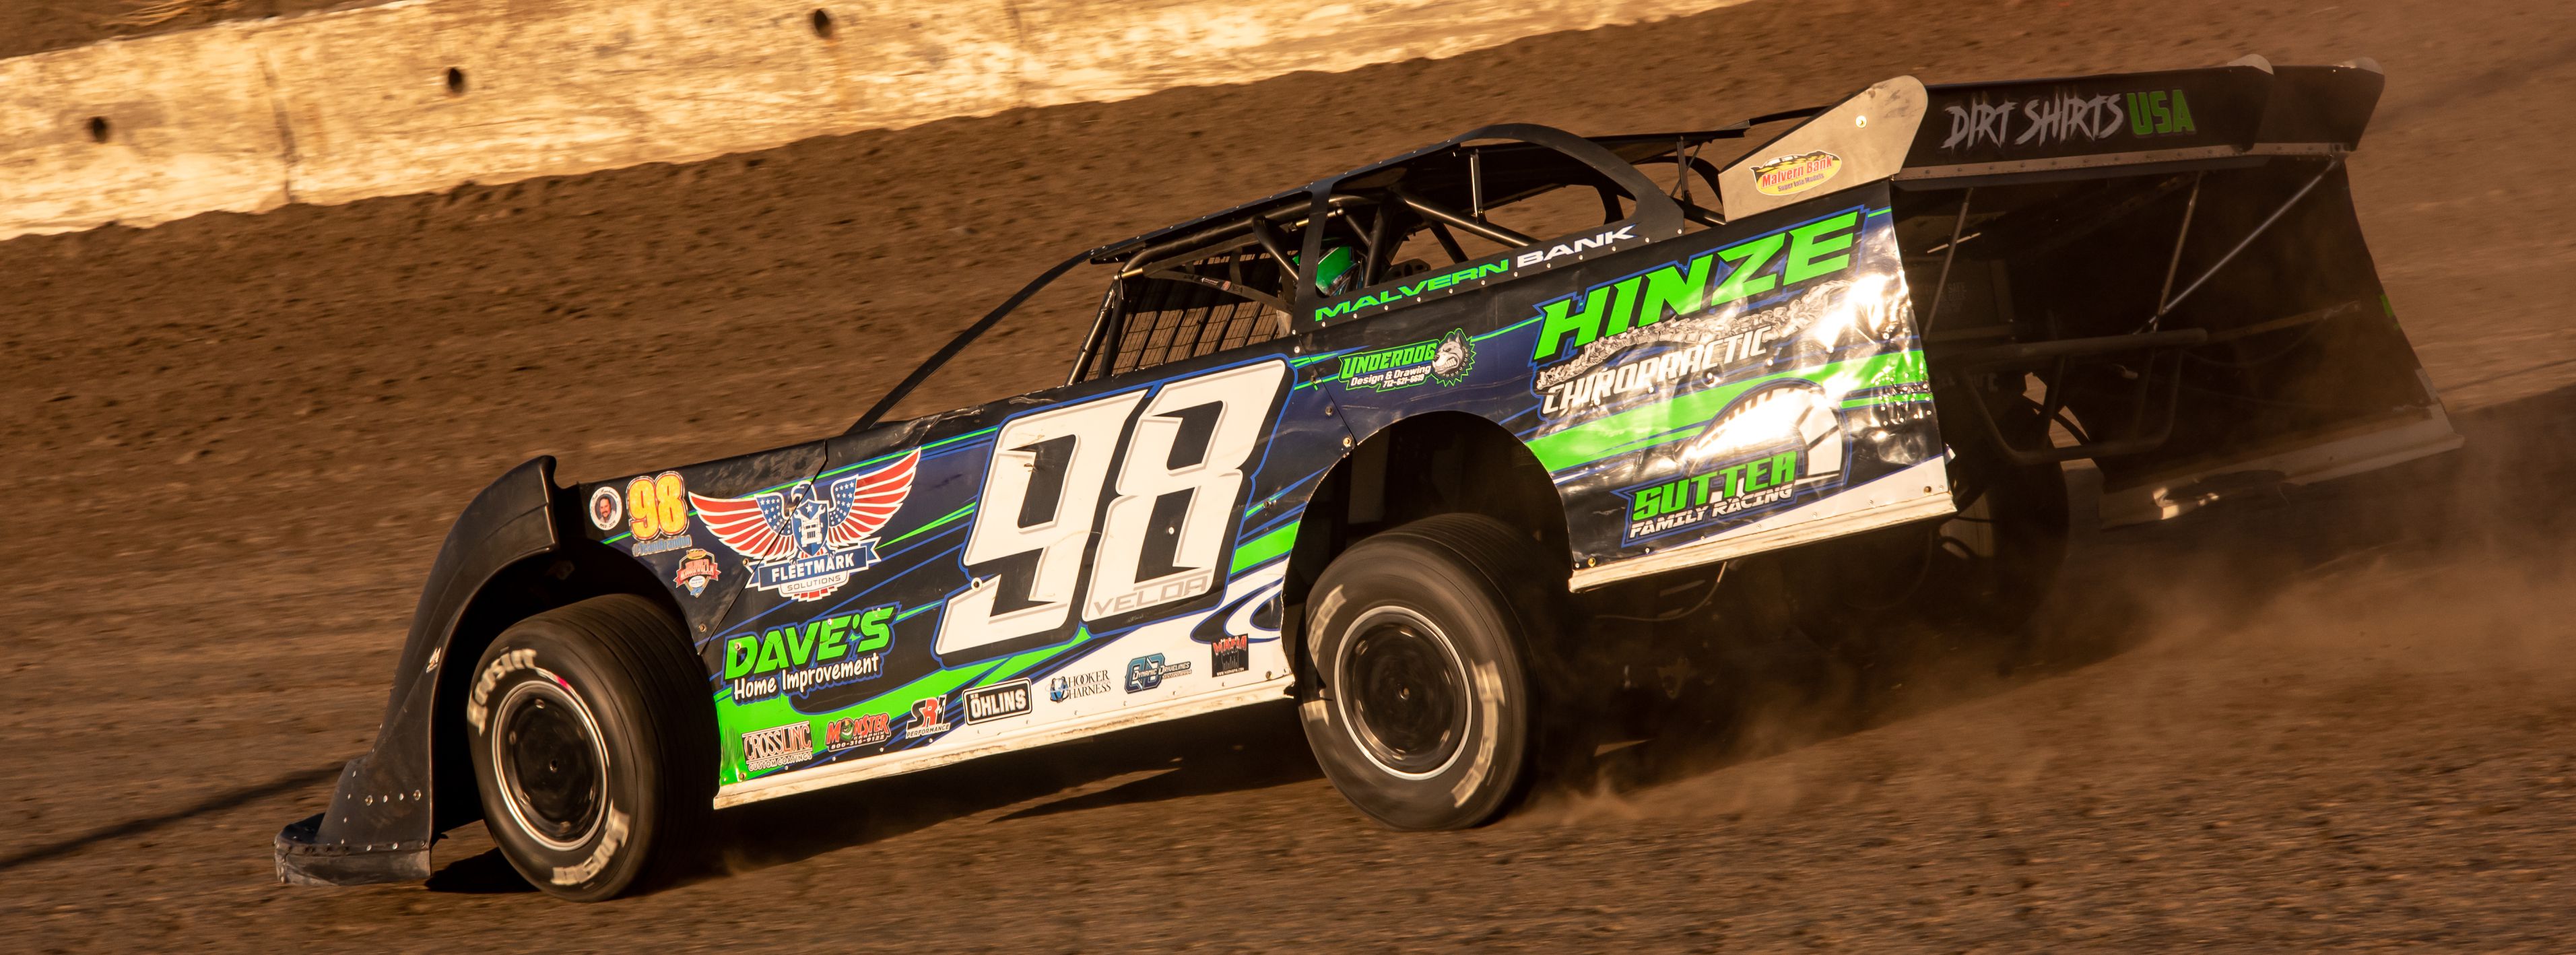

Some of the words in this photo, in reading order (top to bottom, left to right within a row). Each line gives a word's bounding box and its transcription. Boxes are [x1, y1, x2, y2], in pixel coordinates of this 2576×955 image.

[1942, 98, 2018, 149] DIRT
[2015, 93, 2123, 145] SHIRTS
[2127, 90, 2195, 135] USA
[1762, 166, 1804, 188] Malvern
[1806, 155, 1832, 174] Bank
[1778, 183, 1793, 192] Super
[1805, 173, 1824, 183] Models
[1315, 259, 1509, 322] MALVERN
[1517, 223, 1637, 267] BANK
[1533, 211, 1858, 360] HINZE
[1342, 343, 1437, 378] UNDERDOG
[1350, 374, 1383, 387] Design
[1385, 372, 1393, 381] &
[1394, 365, 1431, 378] Drawing
[1542, 325, 1772, 414] CHIROPRACTIC
[1632, 451, 1797, 521] SUTTER
[628, 472, 687, 540] 98
[936, 360, 1286, 655] 98
[1630, 506, 1707, 538] FAMILY
[1712, 485, 1793, 519] RACING
[771, 552, 854, 583] FLEETMARK
[787, 574, 840, 591] SOLUTIONS
[725, 607, 895, 680] DAVE'S
[1213, 635, 1247, 656] MAFIA
[734, 678, 777, 700] Home
[782, 653, 880, 692] Improvement
[1068, 670, 1109, 687] HOOKER
[1133, 669, 1157, 680] DYNAMIC
[1158, 662, 1191, 675] DRIVELINES
[970, 688, 1027, 719] ÖHLINS
[1069, 682, 1111, 699] HARNESS
[744, 725, 812, 760] CROSSLINC
[906, 724, 950, 737] PERFORMANCE
[748, 759, 777, 772] CUSTOM
[777, 752, 812, 765] COATINGS
